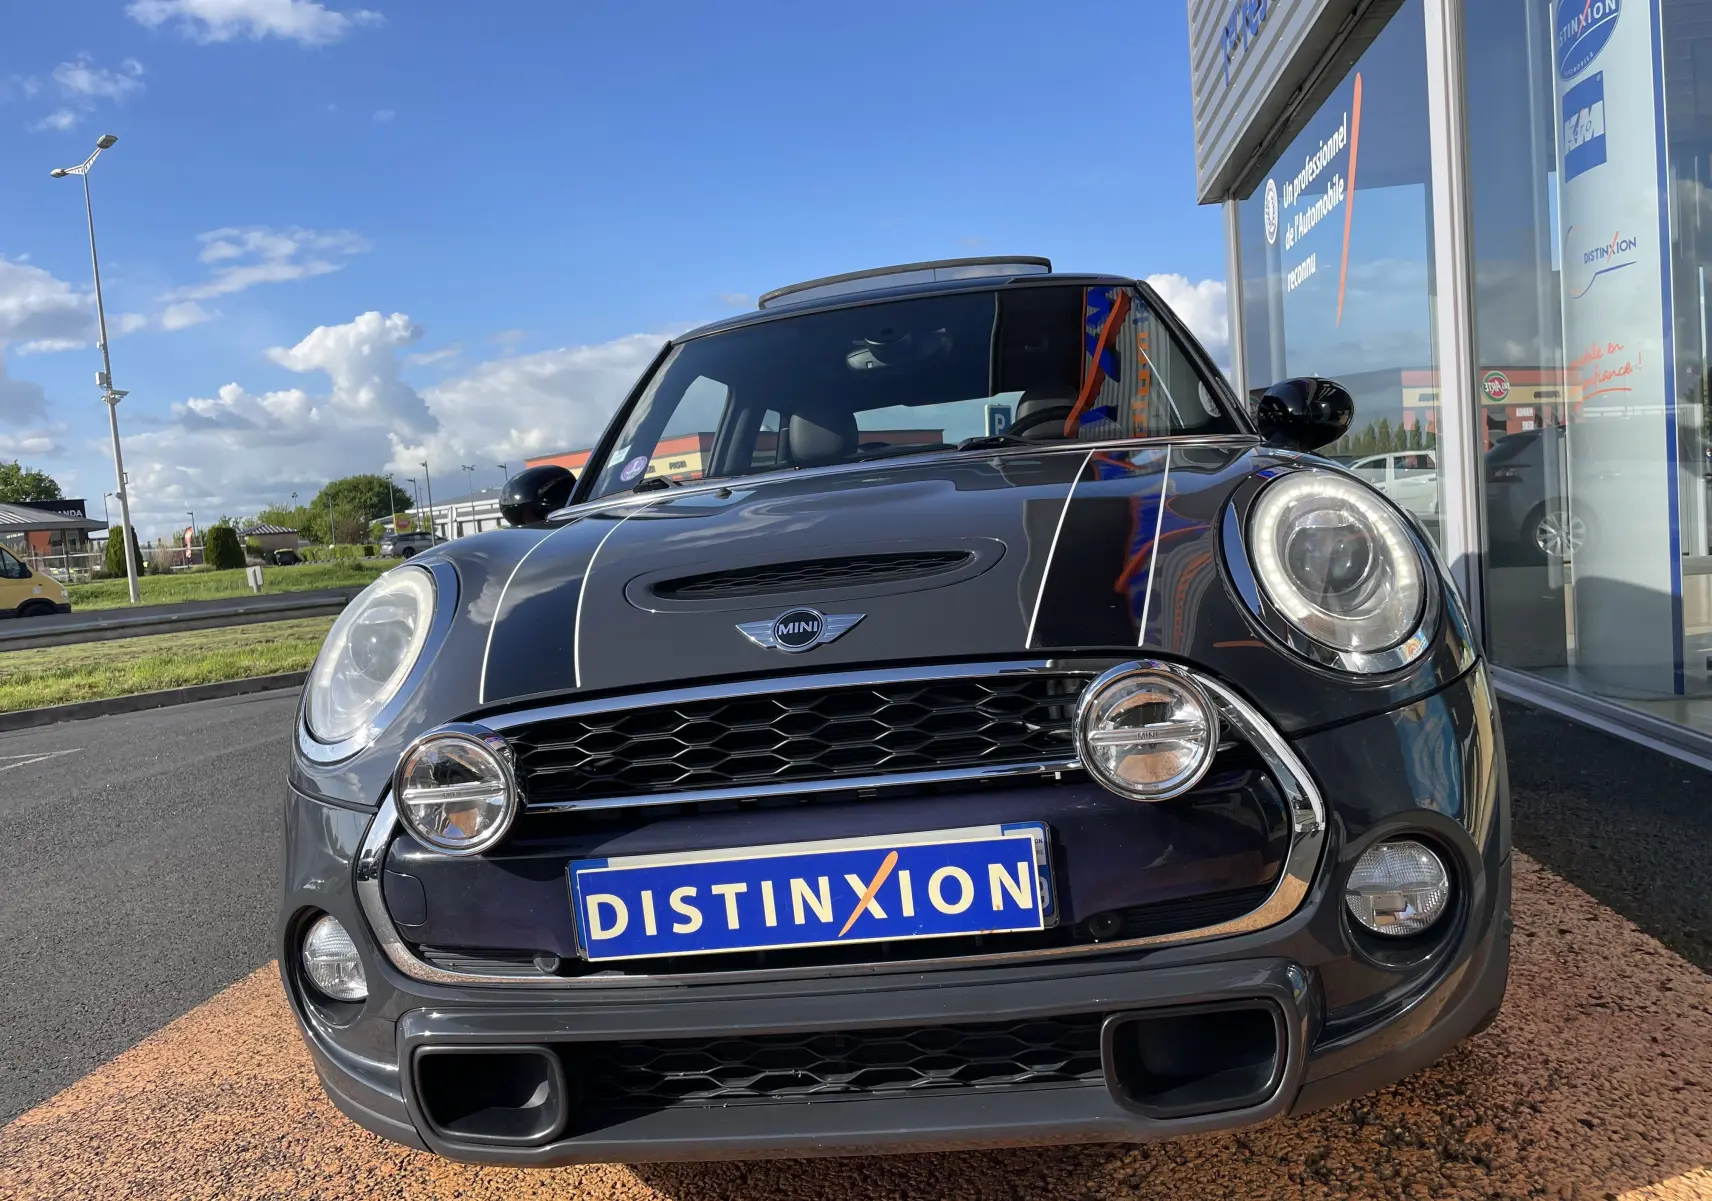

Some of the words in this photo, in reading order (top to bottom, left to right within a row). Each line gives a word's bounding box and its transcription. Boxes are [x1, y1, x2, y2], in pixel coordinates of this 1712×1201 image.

[1283, 182, 1293, 208] Un
[1293, 112, 1347, 206] professionnel
[1285, 223, 1294, 250] de
[1294, 173, 1345, 242] l'Automobile
[1583, 231, 1637, 264] DISTINXION
[1287, 253, 1316, 292] reconnu
[994, 413, 1006, 435] P
[778, 621, 818, 636] MINI
[585, 850, 1034, 941] DISTINXION
